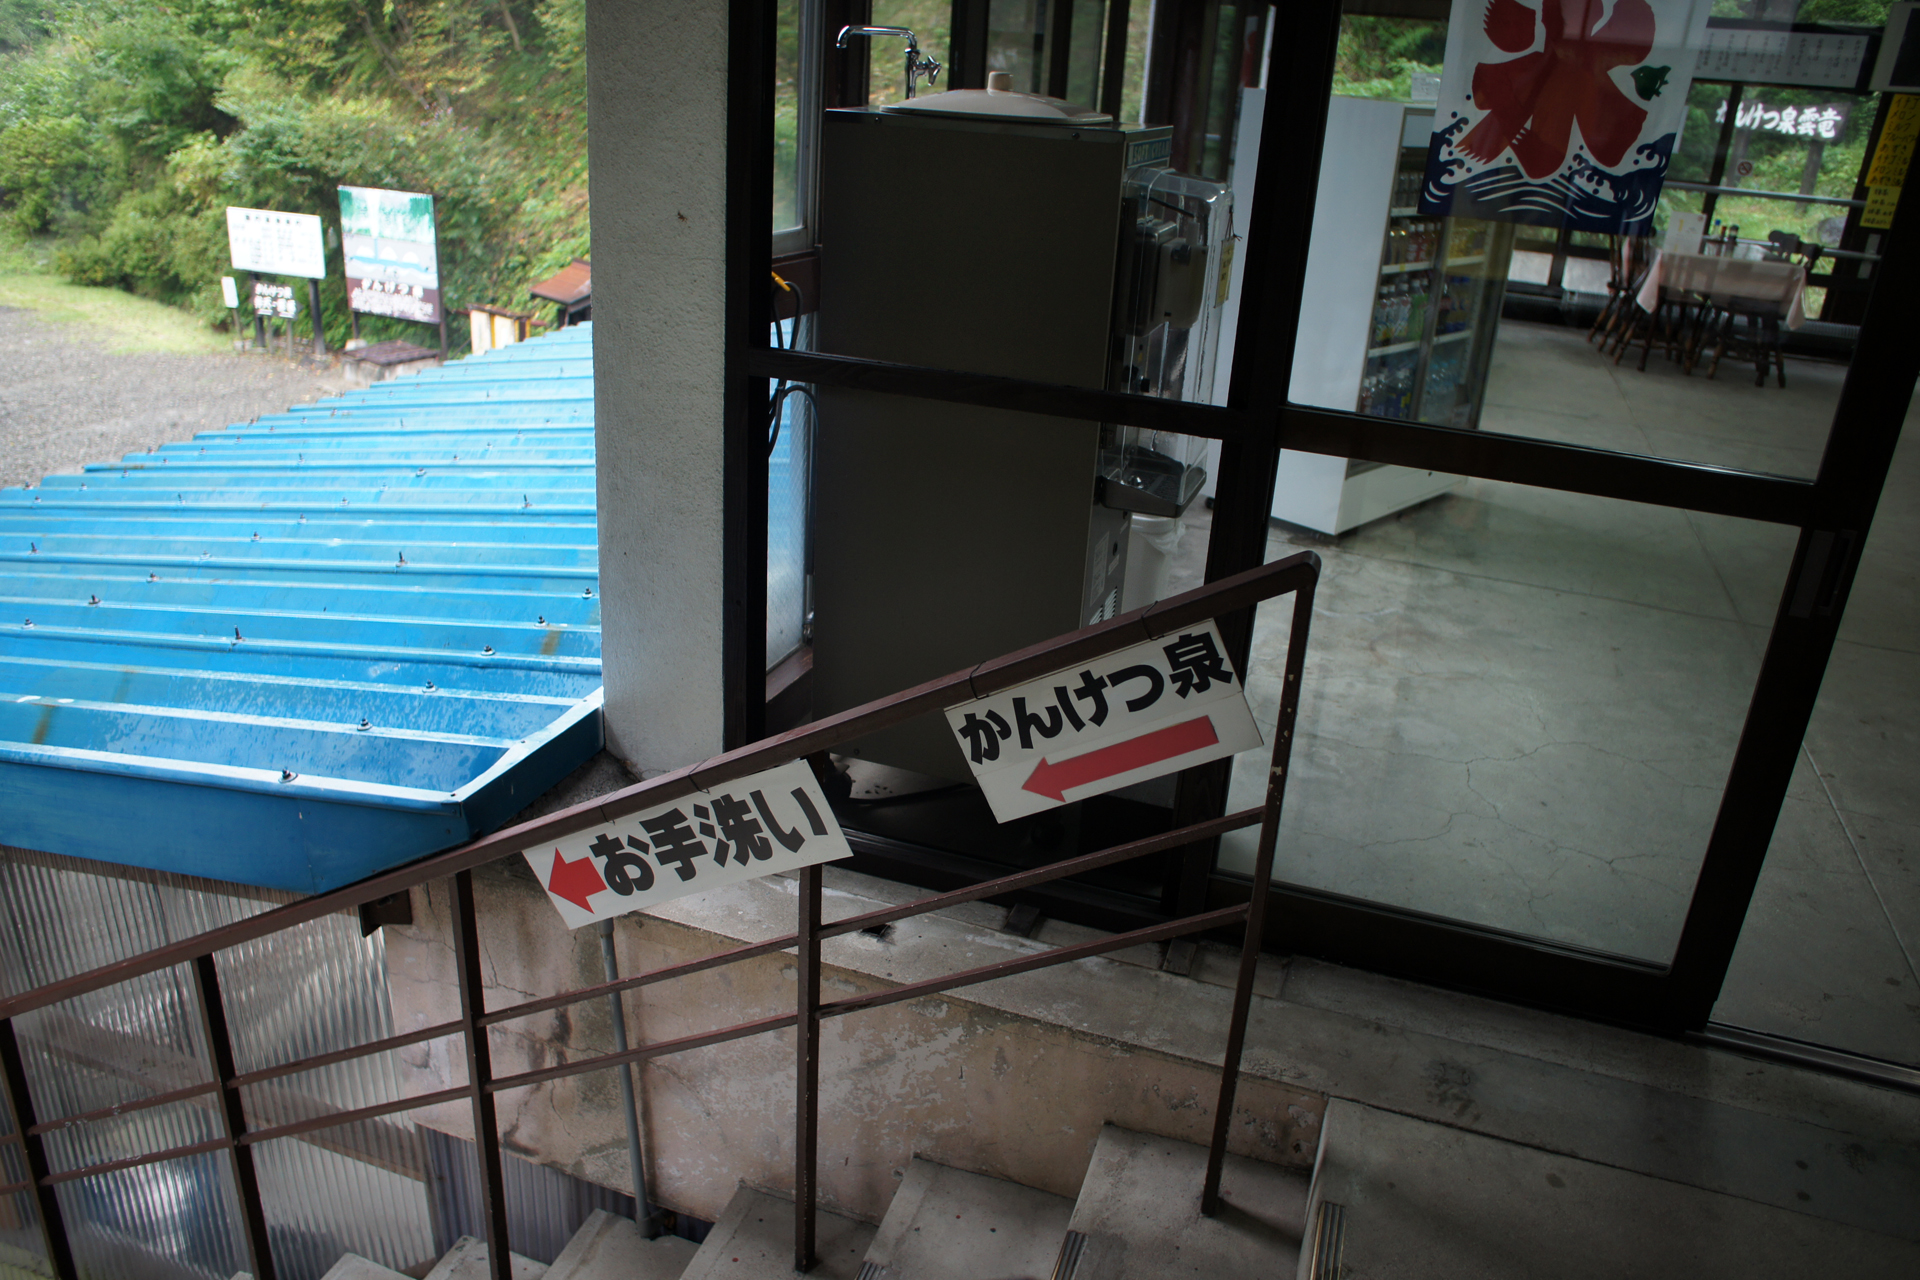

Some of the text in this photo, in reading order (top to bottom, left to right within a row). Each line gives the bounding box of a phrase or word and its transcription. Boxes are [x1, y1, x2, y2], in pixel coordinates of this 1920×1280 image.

[958, 631, 1234, 765] かんけつ泉
[588, 786, 829, 896] お手洗い
